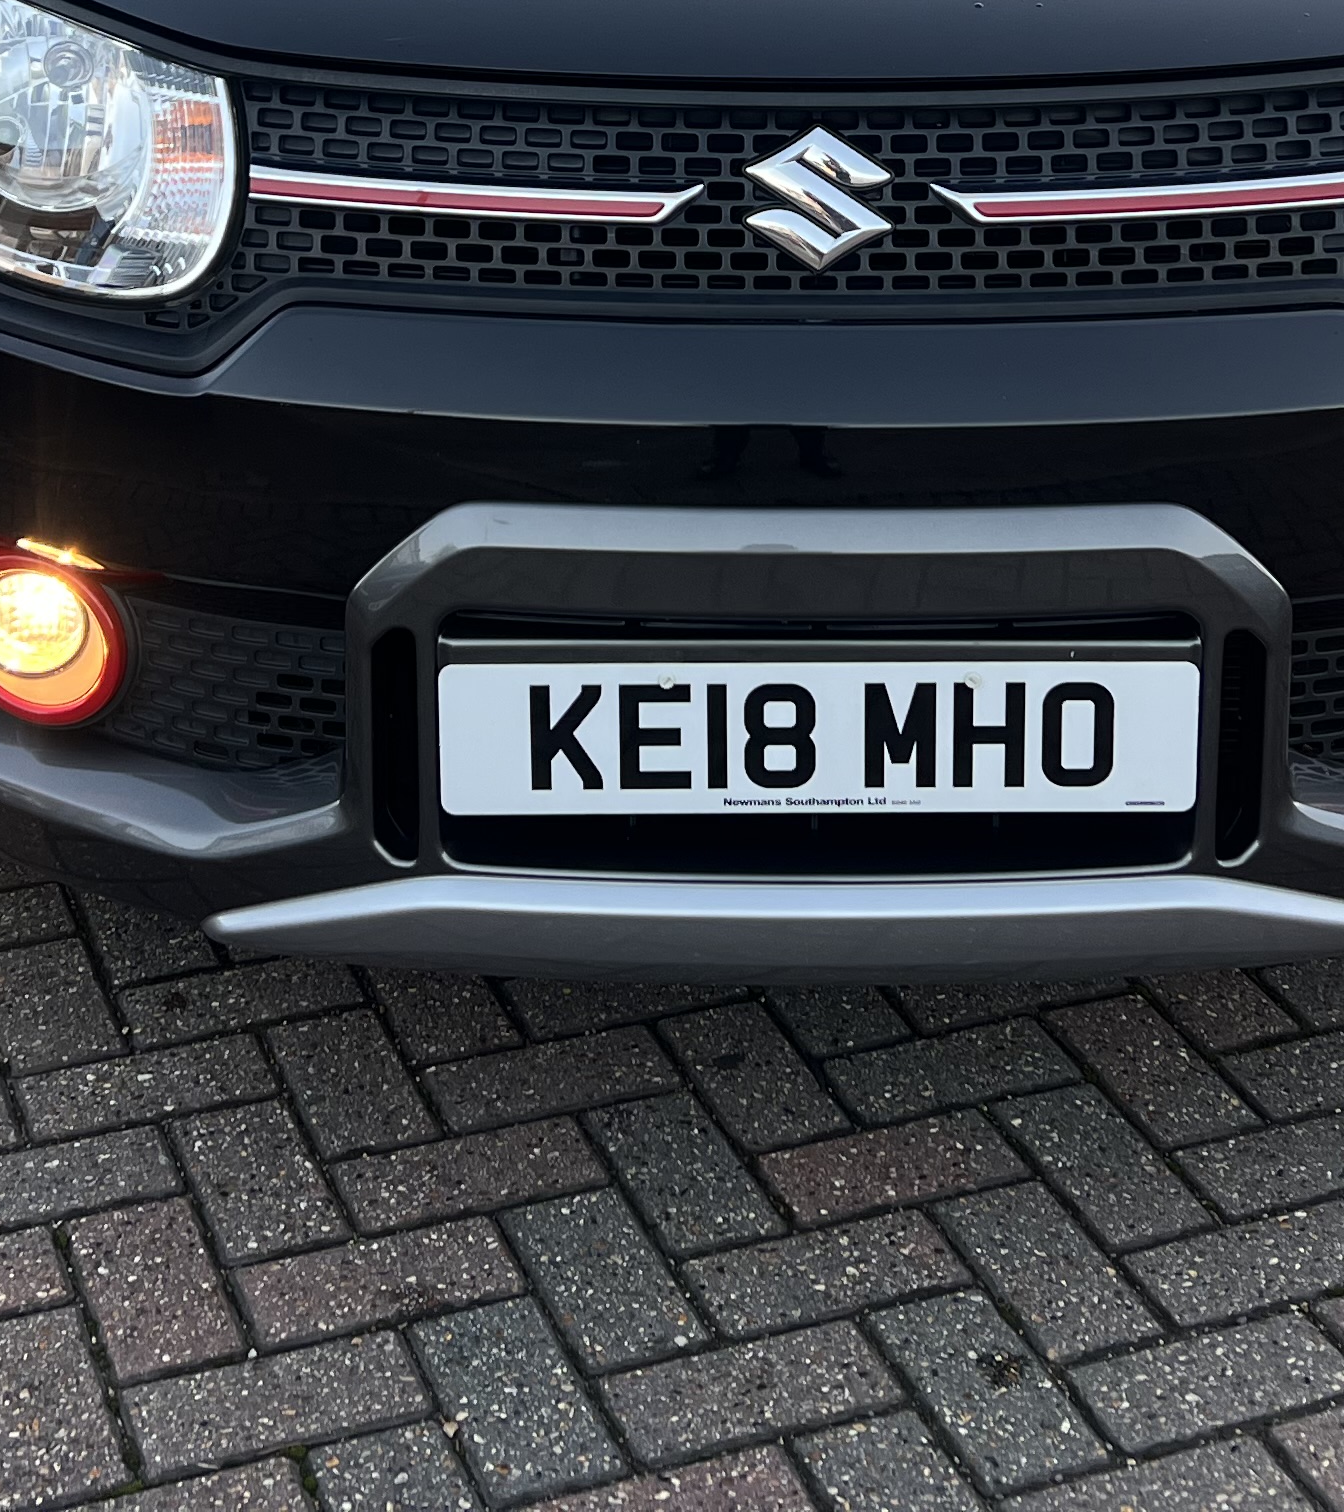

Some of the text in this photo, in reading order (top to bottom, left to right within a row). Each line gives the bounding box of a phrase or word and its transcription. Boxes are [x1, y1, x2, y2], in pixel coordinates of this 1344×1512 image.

[529, 682, 1115, 790] KE18 MHO
[723, 797, 782, 807] Newmans
[785, 797, 864, 807] Southampton
[867, 797, 887, 806] Ltd
